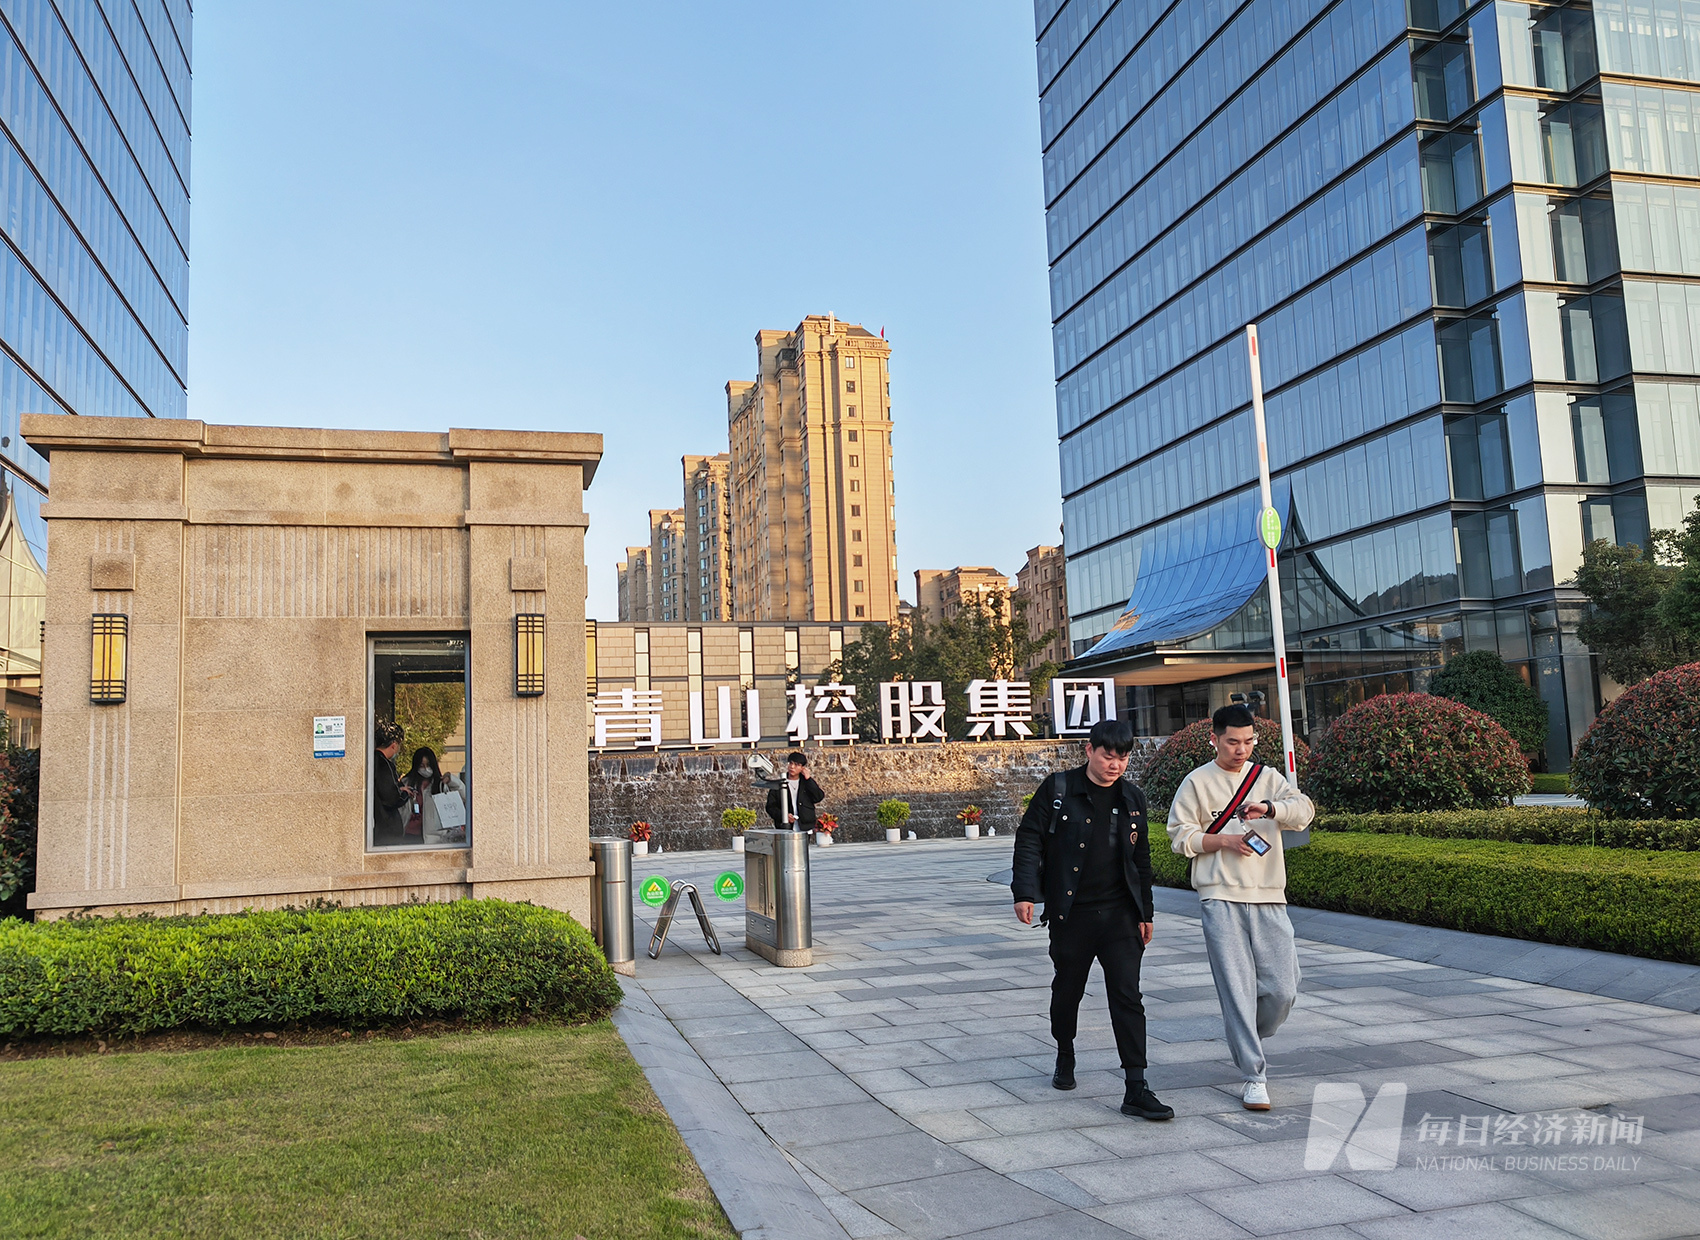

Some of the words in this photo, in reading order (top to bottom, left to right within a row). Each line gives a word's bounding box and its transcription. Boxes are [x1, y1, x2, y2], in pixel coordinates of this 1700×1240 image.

[592, 677, 1117, 747] 青山控股集团
